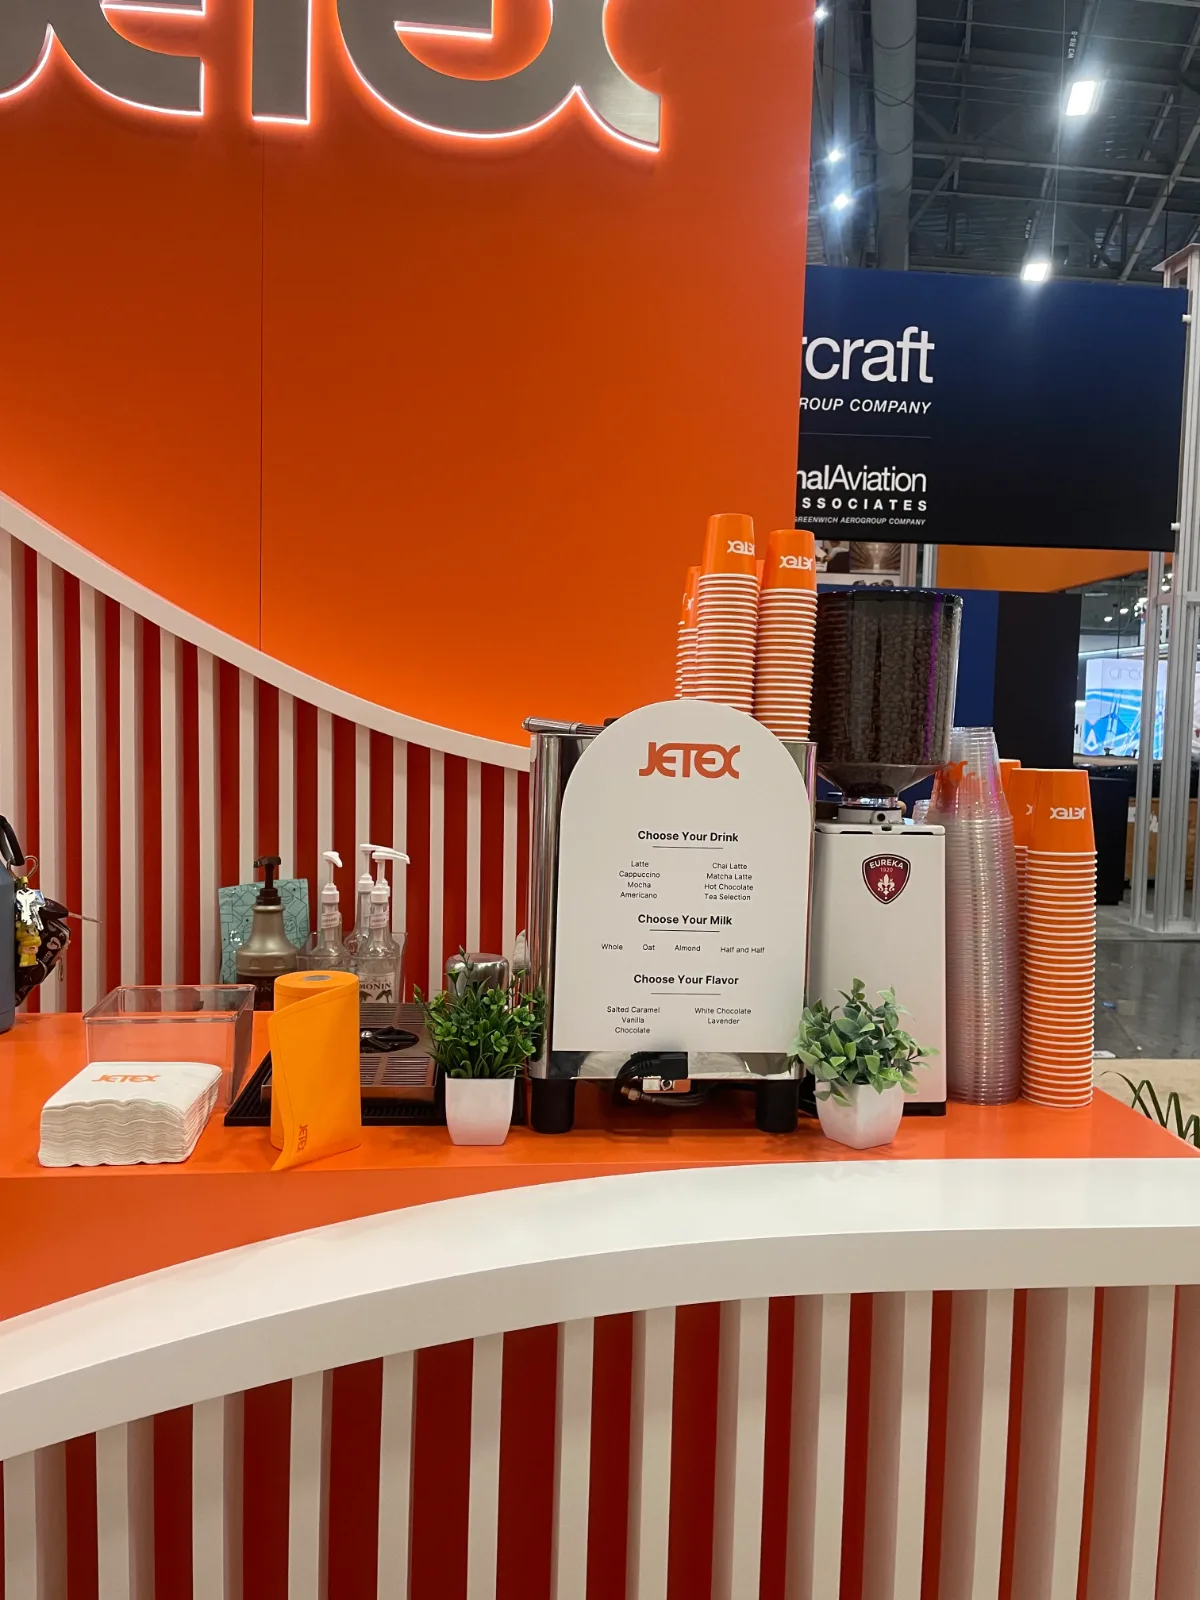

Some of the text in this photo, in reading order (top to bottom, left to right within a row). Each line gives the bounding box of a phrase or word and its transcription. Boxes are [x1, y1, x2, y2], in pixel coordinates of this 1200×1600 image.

[849, 399, 932, 414] COMPANY
[802, 497, 927, 511] SSOCIATES
[840, 516, 887, 525] AEROGROUP
[888, 517, 926, 526] COMPANY
[639, 742, 740, 779] JETEX
[638, 831, 739, 842] Choose Your Drink
[712, 862, 728, 870] Chai
[869, 859, 903, 869] EUREKA
[619, 870, 661, 880] Cappuccino
[706, 872, 753, 881] Matcha Latte
[704, 883, 754, 892] Hot Chocolate
[719, 893, 751, 901] Selection
[638, 914, 733, 925] Choose Your Milk
[601, 943, 623, 951] Whole
[642, 943, 655, 951] Oat
[674, 944, 701, 952] Almond
[720, 946, 765, 954] Half and Half
[633, 974, 739, 985] Choose Your Flavor
[694, 1007, 752, 1015] White Chocolate
[621, 1016, 645, 1024] Vanilla
[707, 1017, 740, 1025] Lavender
[614, 1026, 651, 1034] Chocolate
